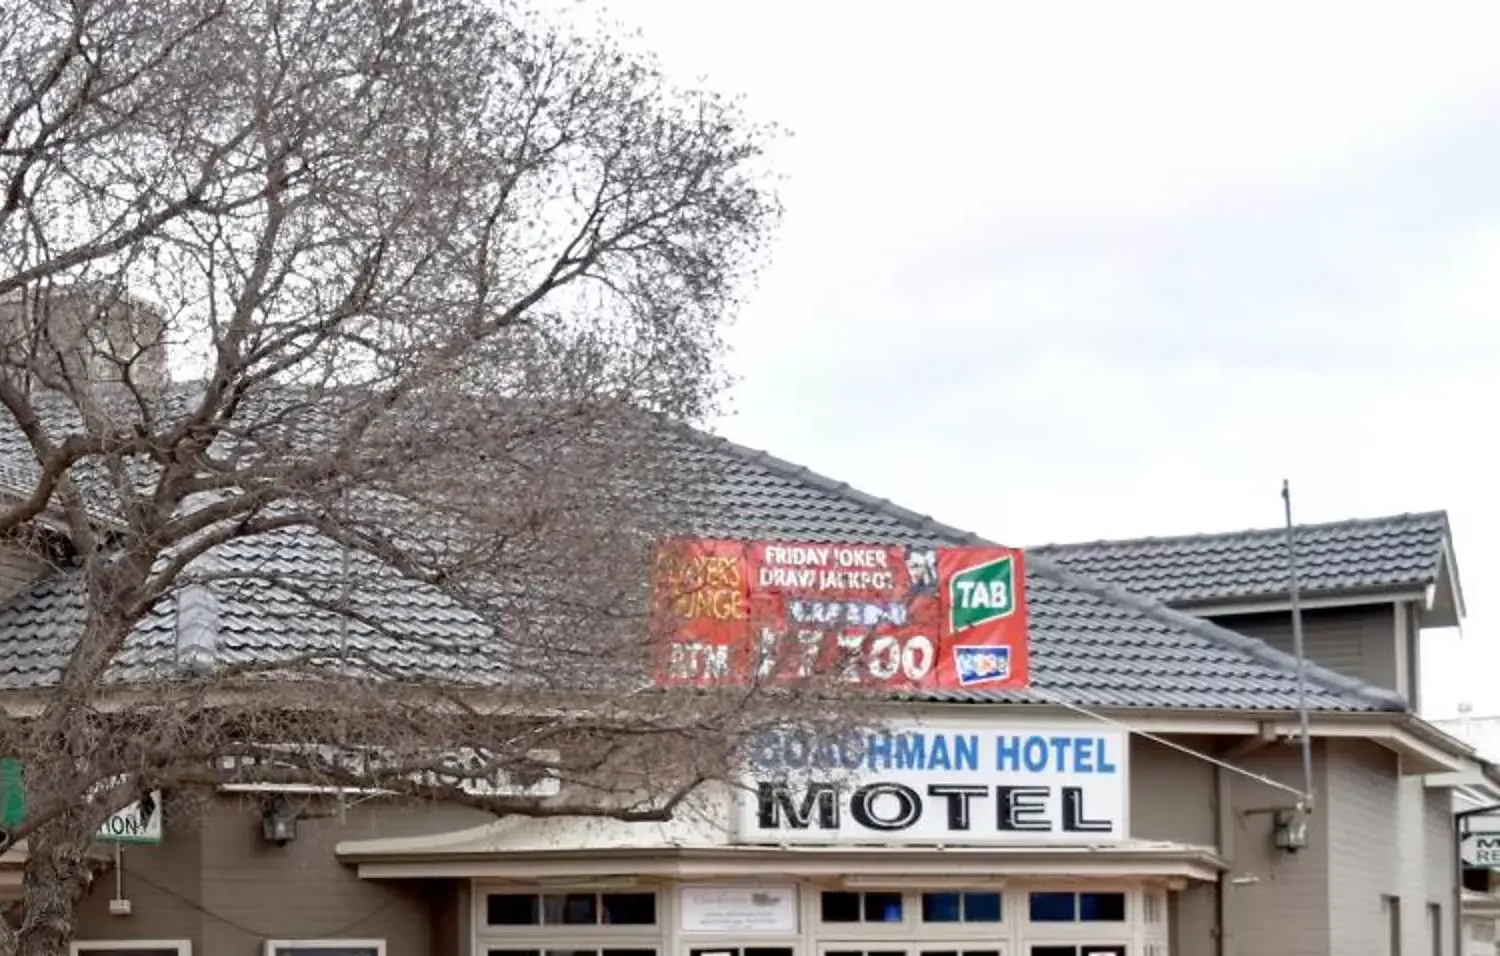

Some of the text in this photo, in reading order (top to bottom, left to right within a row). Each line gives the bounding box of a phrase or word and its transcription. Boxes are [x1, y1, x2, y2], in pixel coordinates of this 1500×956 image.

[764, 546, 829, 567] FRIDAY
[956, 581, 1008, 609] TAB
[996, 734, 1117, 774] HOTEL
[757, 780, 1114, 833] MOTEL
